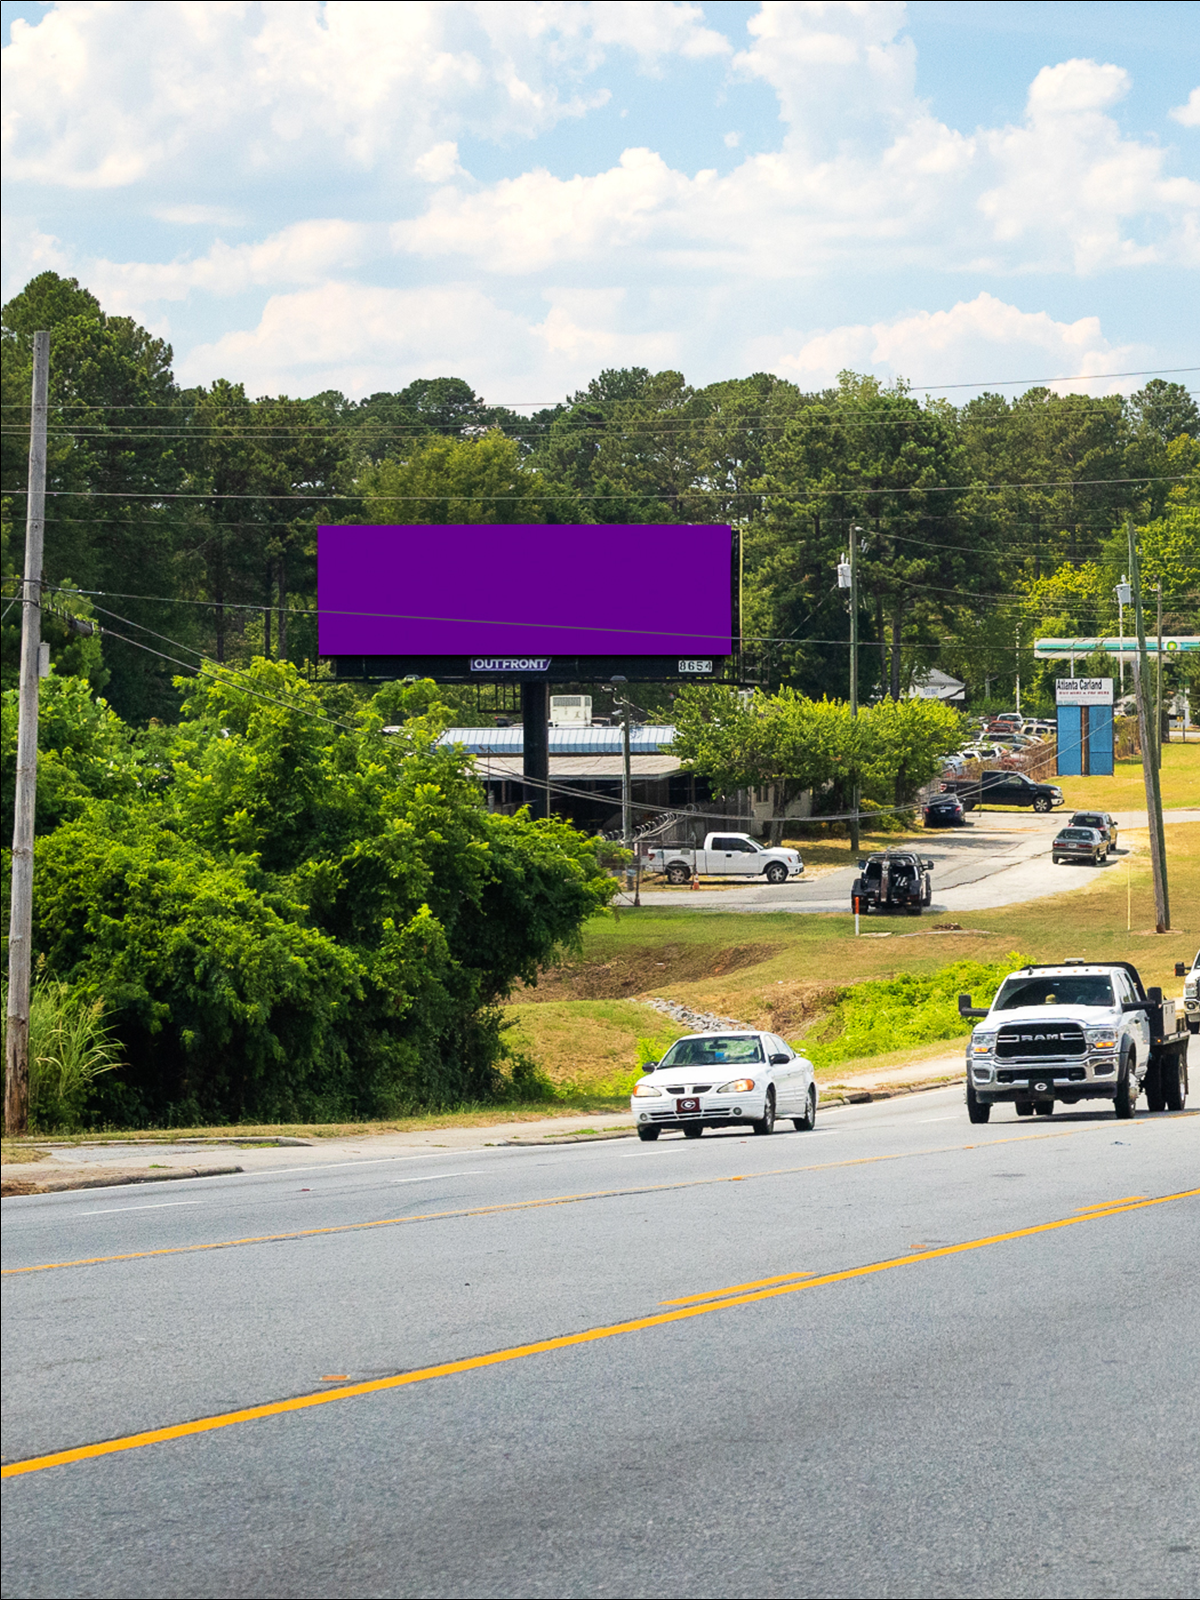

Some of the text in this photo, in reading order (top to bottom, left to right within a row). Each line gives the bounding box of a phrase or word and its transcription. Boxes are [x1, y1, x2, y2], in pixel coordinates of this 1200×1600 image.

[474, 658, 547, 669] OUTFRONT
[680, 660, 711, 671] 8654
[1021, 1033, 1059, 1042] RAM
